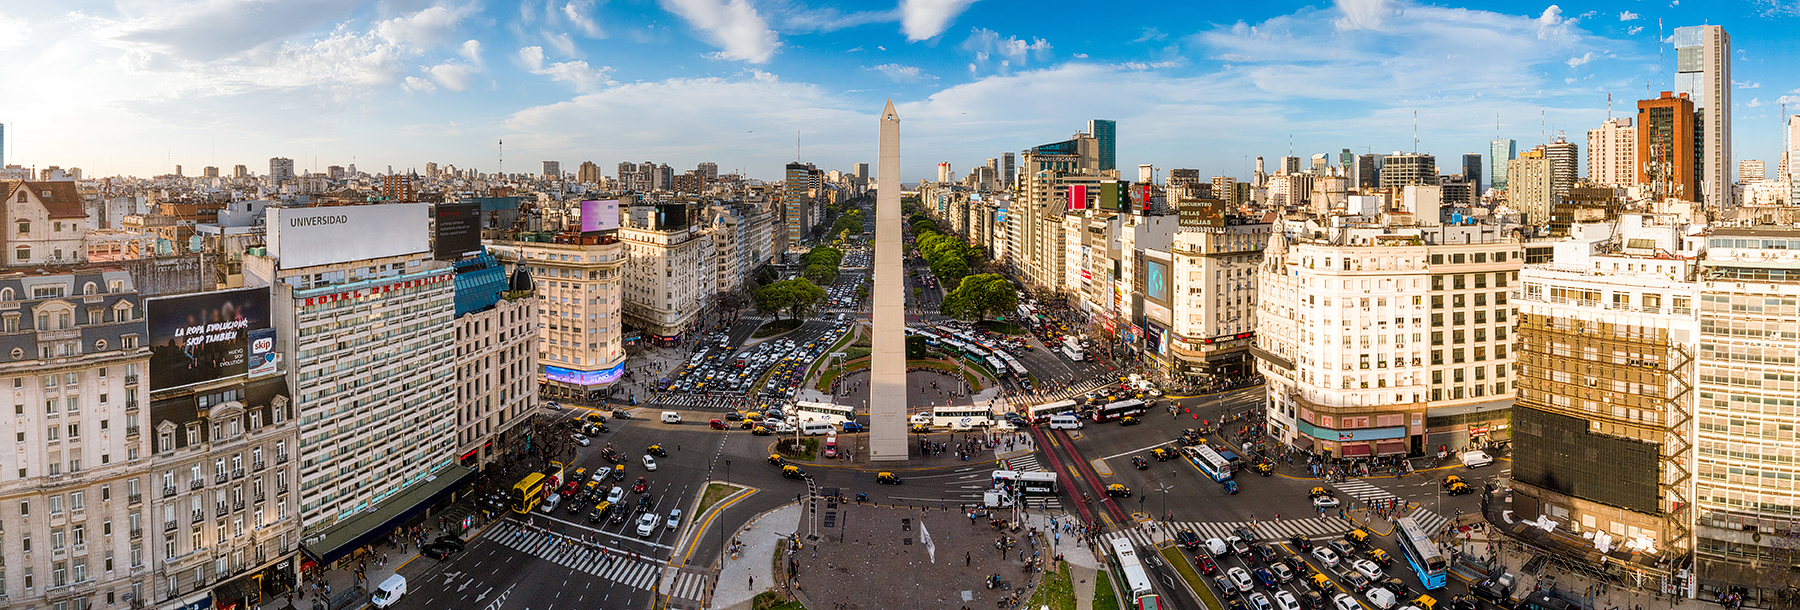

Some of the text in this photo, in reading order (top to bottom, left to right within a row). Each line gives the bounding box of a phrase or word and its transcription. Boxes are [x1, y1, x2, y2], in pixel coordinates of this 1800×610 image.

[290, 215, 348, 227] UNIVERSIDAD
[305, 273, 454, 306] HOTEL REPUBLICA
[175, 328, 184, 337] LA
[186, 325, 204, 336] ROPA
[186, 331, 237, 346] SKIP TAMBIÉN
[255, 340, 270, 350] skip
